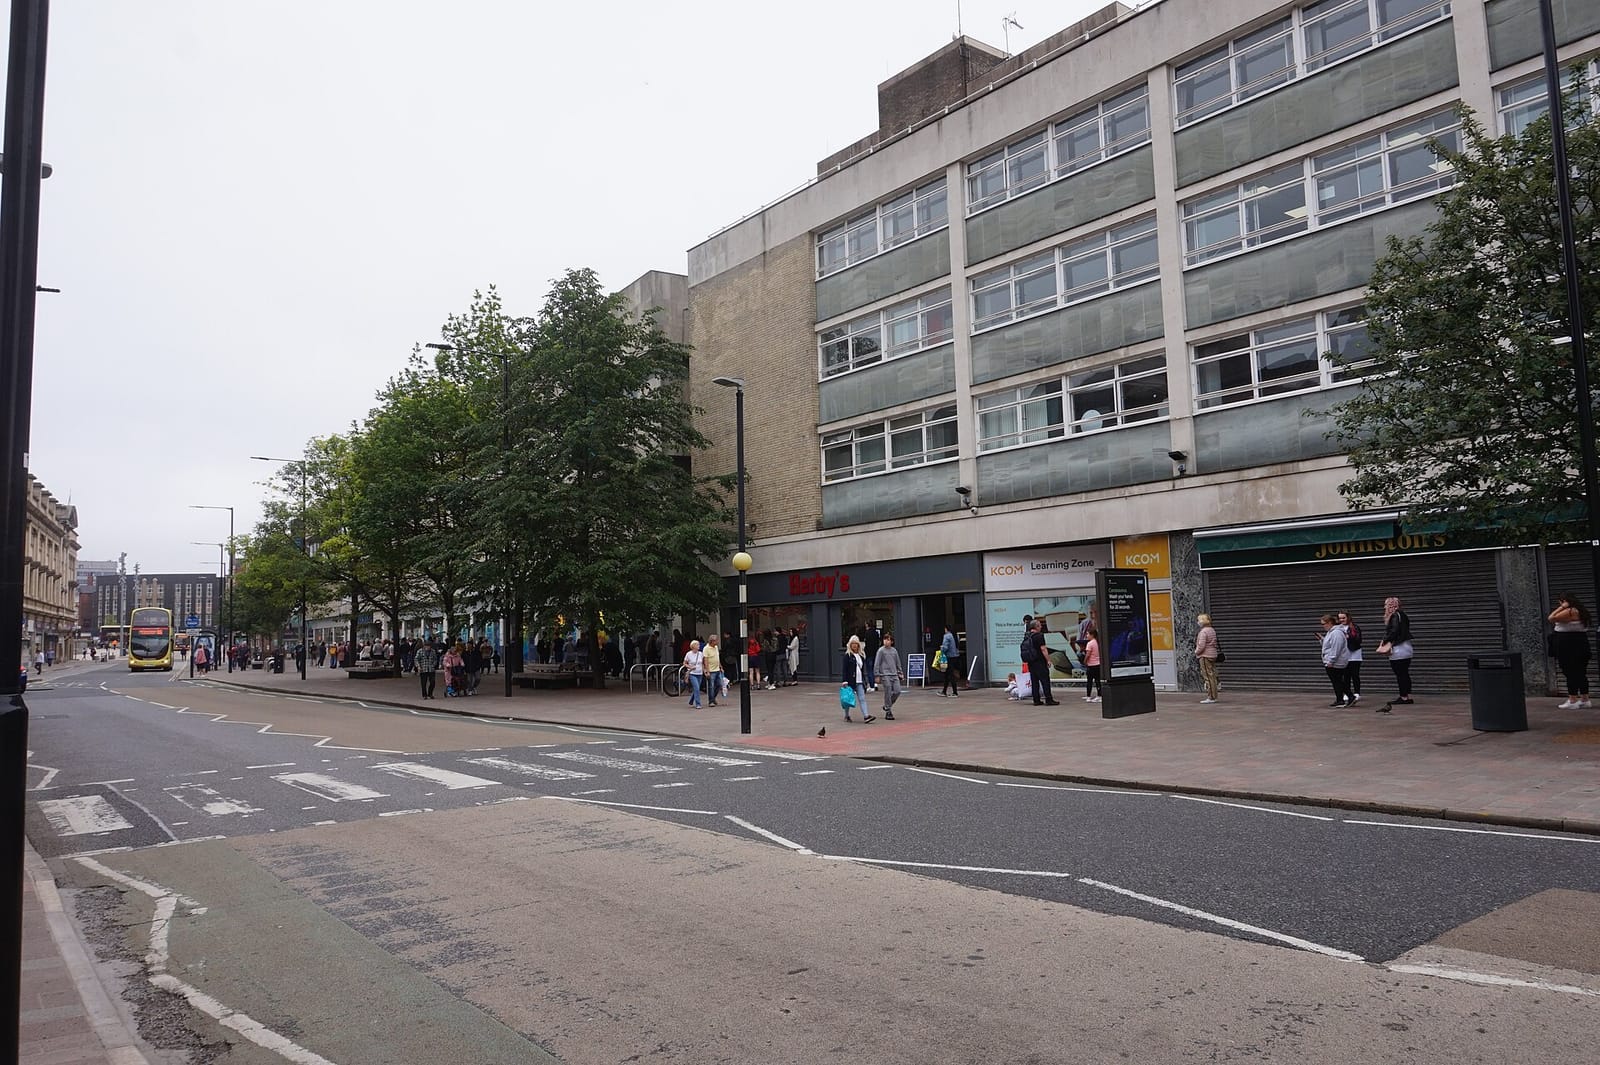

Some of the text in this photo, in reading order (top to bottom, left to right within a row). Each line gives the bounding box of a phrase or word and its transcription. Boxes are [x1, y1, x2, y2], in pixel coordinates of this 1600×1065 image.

[1315, 533, 1446, 559] Jonstons
[1030, 559, 1095, 570] Learning Zone
[1125, 553, 1160, 566] KCOM
[990, 565, 1024, 577] KCOM
[788, 568, 850, 598] Herby's
